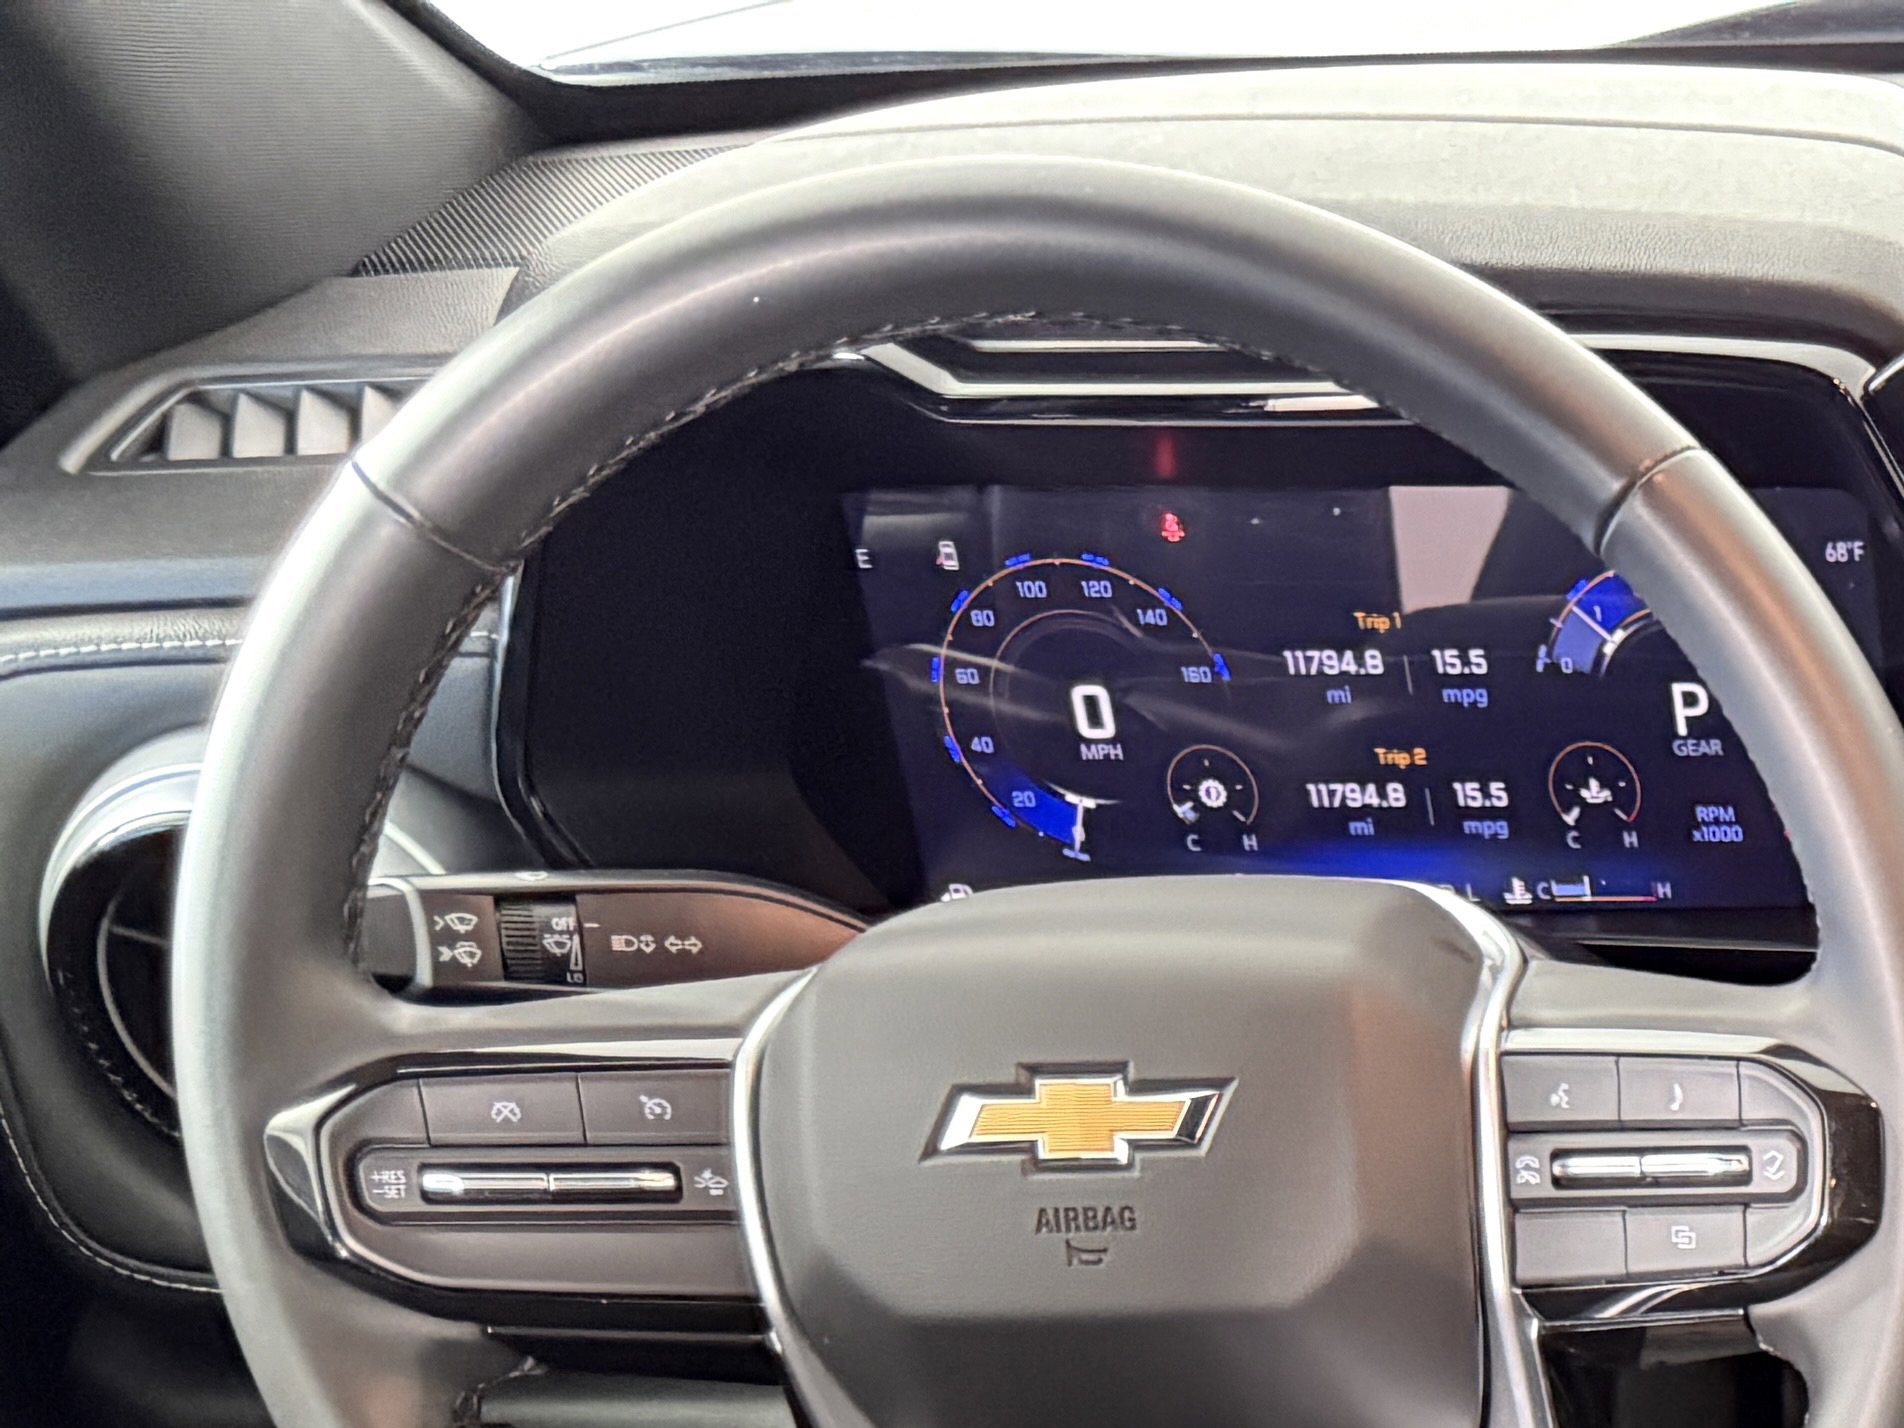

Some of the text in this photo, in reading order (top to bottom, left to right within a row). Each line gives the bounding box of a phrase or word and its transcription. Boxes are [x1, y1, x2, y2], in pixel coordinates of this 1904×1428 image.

[855, 548, 873, 569] E
[1016, 581, 1047, 599] 100
[1081, 581, 1113, 599] 120
[970, 610, 995, 627] 80
[1136, 608, 1168, 626] 140
[1353, 611, 1403, 634] Trip 1
[1282, 649, 1385, 676] 11794.8
[1431, 648, 1489, 676] 15.5
[955, 667, 980, 685] 60
[1180, 666, 1214, 684] 160
[1326, 685, 1352, 705] mi
[1441, 687, 1489, 709] mpg
[1069, 684, 1117, 740] 0
[1670, 681, 1710, 737] P
[970, 737, 994, 754] 40
[1080, 743, 1124, 762] MPH
[1672, 739, 1724, 757] GEAR
[1374, 746, 1429, 770] Trip 2
[1012, 790, 1036, 808] 20
[1305, 782, 1407, 810] 11794.8
[1452, 781, 1509, 810] 15.5
[1695, 805, 1735, 823] RPM
[1348, 816, 1376, 837] mi
[1463, 820, 1509, 842] mpg
[1692, 825, 1744, 843] x1000
[1186, 834, 1202, 852] C
[1242, 834, 1258, 852] H
[1566, 832, 1582, 850] C
[1623, 832, 1639, 849] H
[1536, 881, 1550, 900] C
[1656, 881, 1673, 900] H
[551, 916, 576, 931] OFF
[1035, 1204, 1138, 1235] AIRBAG
